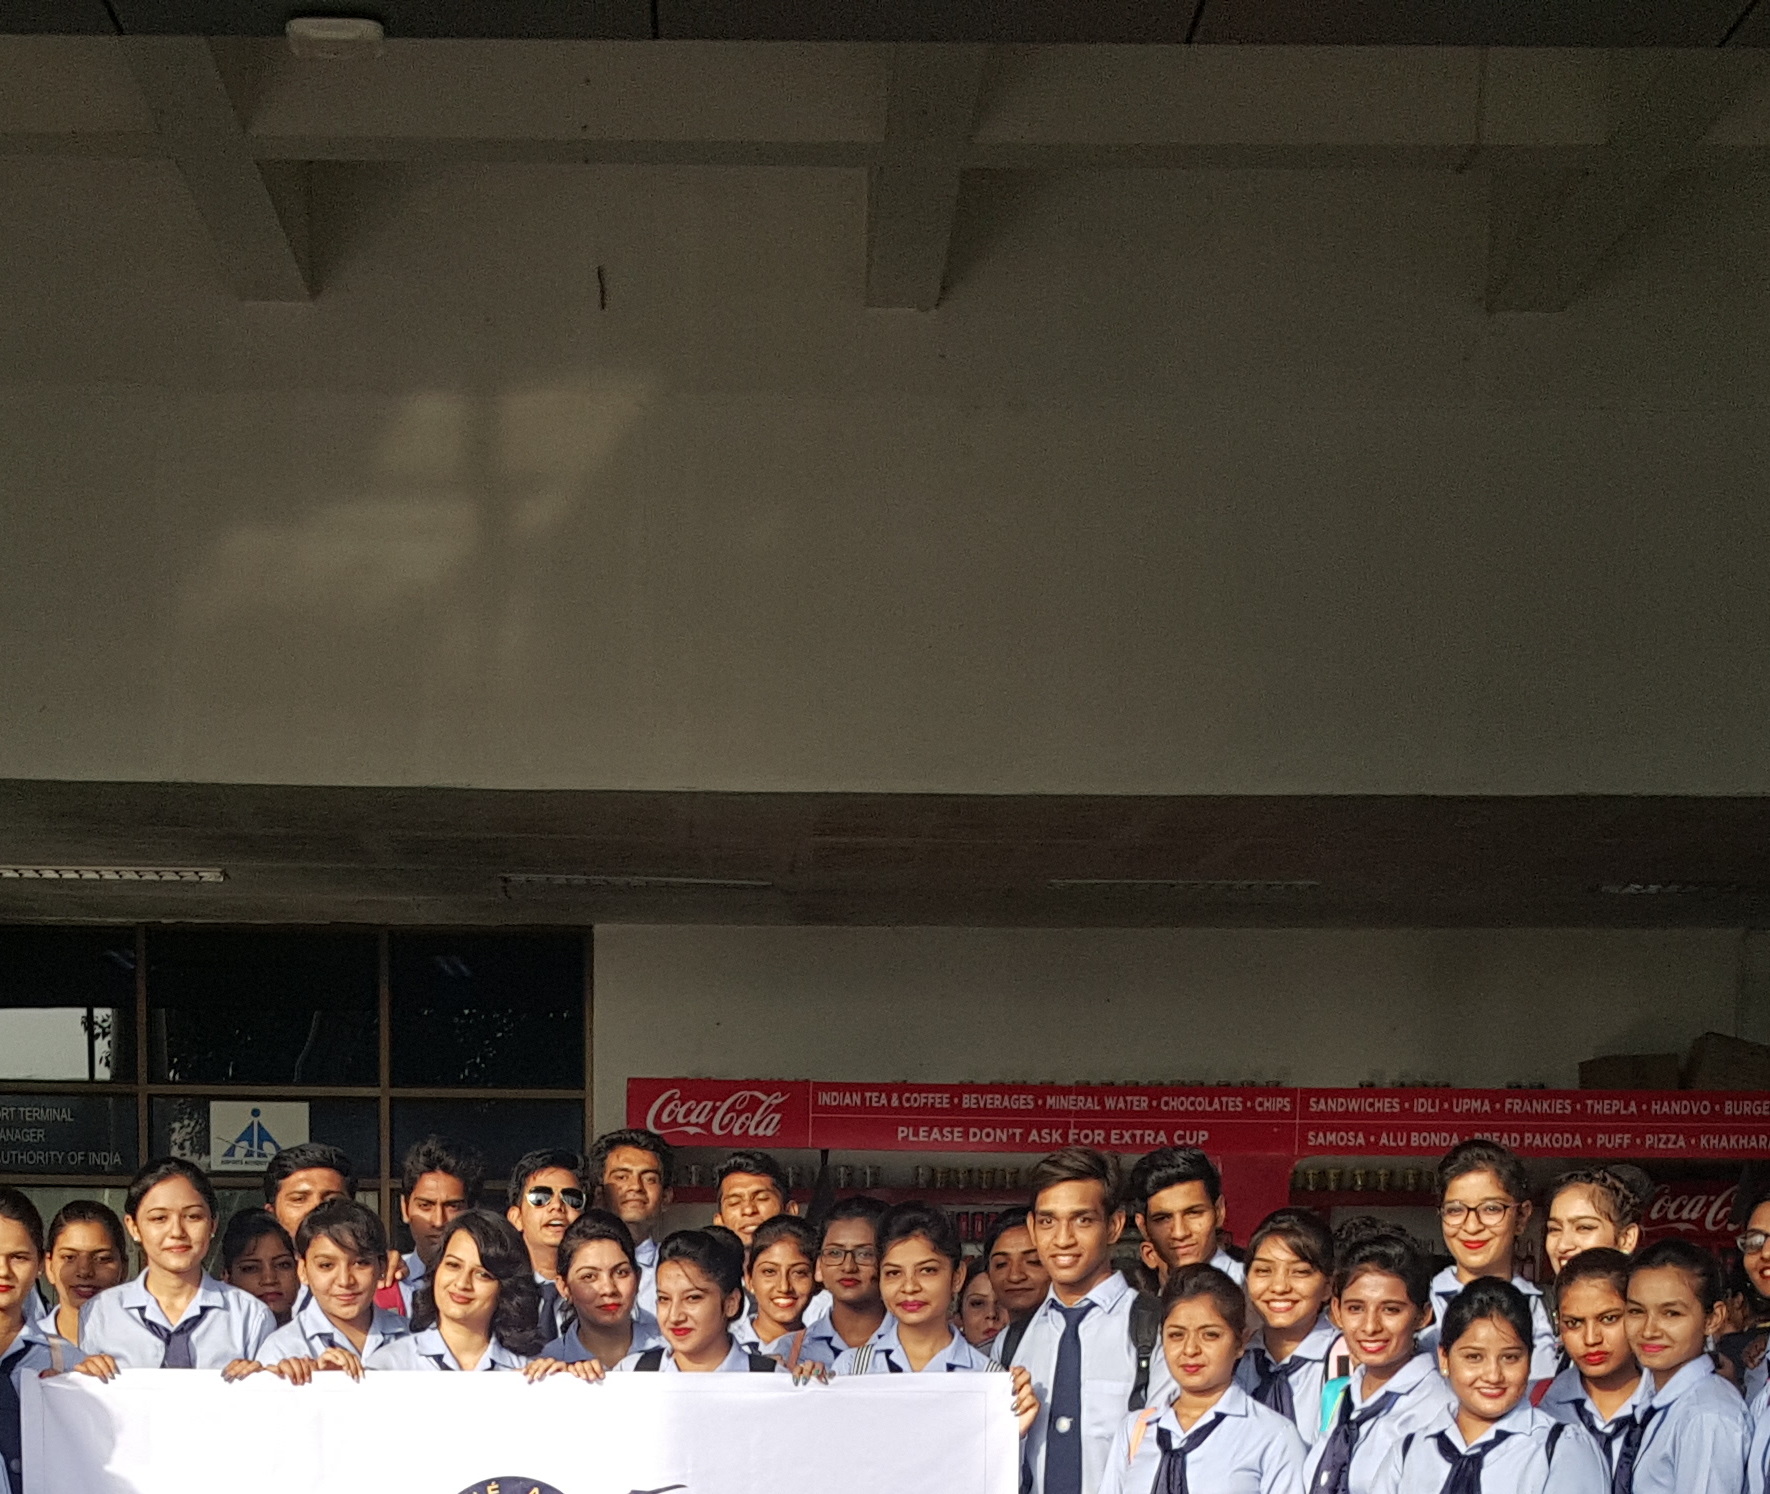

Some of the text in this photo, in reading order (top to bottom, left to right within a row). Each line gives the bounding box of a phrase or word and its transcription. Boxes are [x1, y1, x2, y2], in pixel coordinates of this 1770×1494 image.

[818, 1091, 1291, 1112] INDIAN TEA & COFFEE BEVERAGES MINERAL WATER CHOCOLATES CHIPS
[1309, 1097, 1400, 1113] SANDWICHES
[1413, 1098, 1439, 1113] IDLI
[1452, 1098, 1491, 1114] UPMA
[1504, 1098, 1572, 1115] FRANKIES
[1585, 1099, 1637, 1115] THEPLA
[1651, 1100, 1711, 1116] HANDVO
[19, 1108, 74, 1122] TERMINAL
[646, 1088, 791, 1136] Coca-Cola
[897, 1126, 1209, 1145] PLEASE DON'T ASK FOR EXTRA CUP
[1307, 1131, 1365, 1146] SAMOSA
[1379, 1132, 1406, 1146] ALU
[1410, 1132, 1459, 1147] BONDA
[1524, 1133, 1583, 1148] PAKODA
[1596, 1134, 1632, 1148] PUFF
[1645, 1134, 1686, 1149] PIZZA
[68, 1152, 85, 1165] OF
[89, 1152, 122, 1166] INDIA
